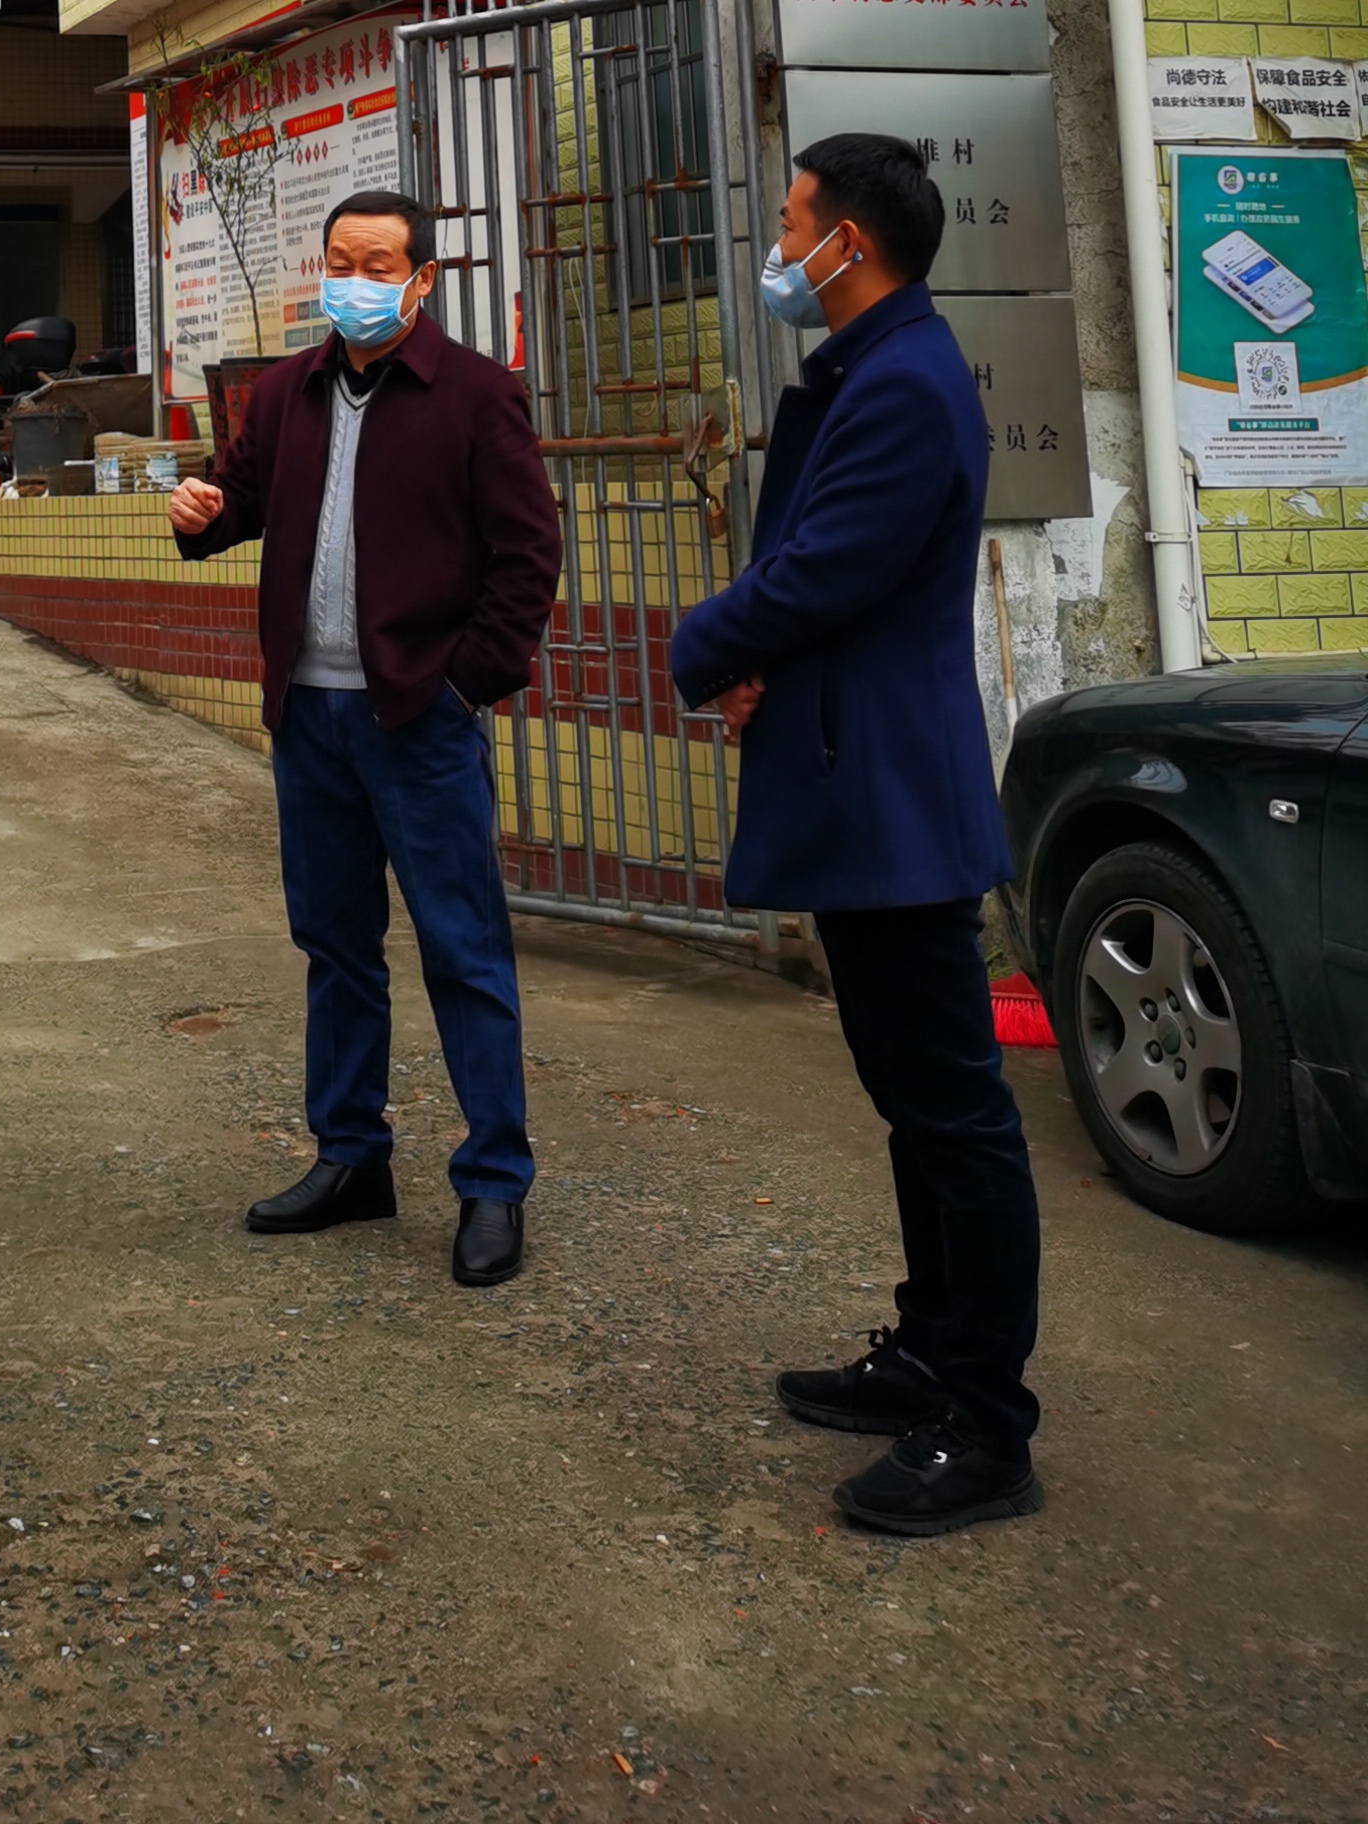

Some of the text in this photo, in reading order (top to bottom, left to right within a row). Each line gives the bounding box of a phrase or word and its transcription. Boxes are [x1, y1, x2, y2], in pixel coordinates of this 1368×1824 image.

[1166, 68, 1228, 86] 尚德守法
[1256, 69, 1348, 87] 保障食品安全
[1152, 96, 1246, 108] 食品安全让生活更美好
[1261, 97, 1351, 118] 构建和谐社会
[973, 363, 995, 390] 村
